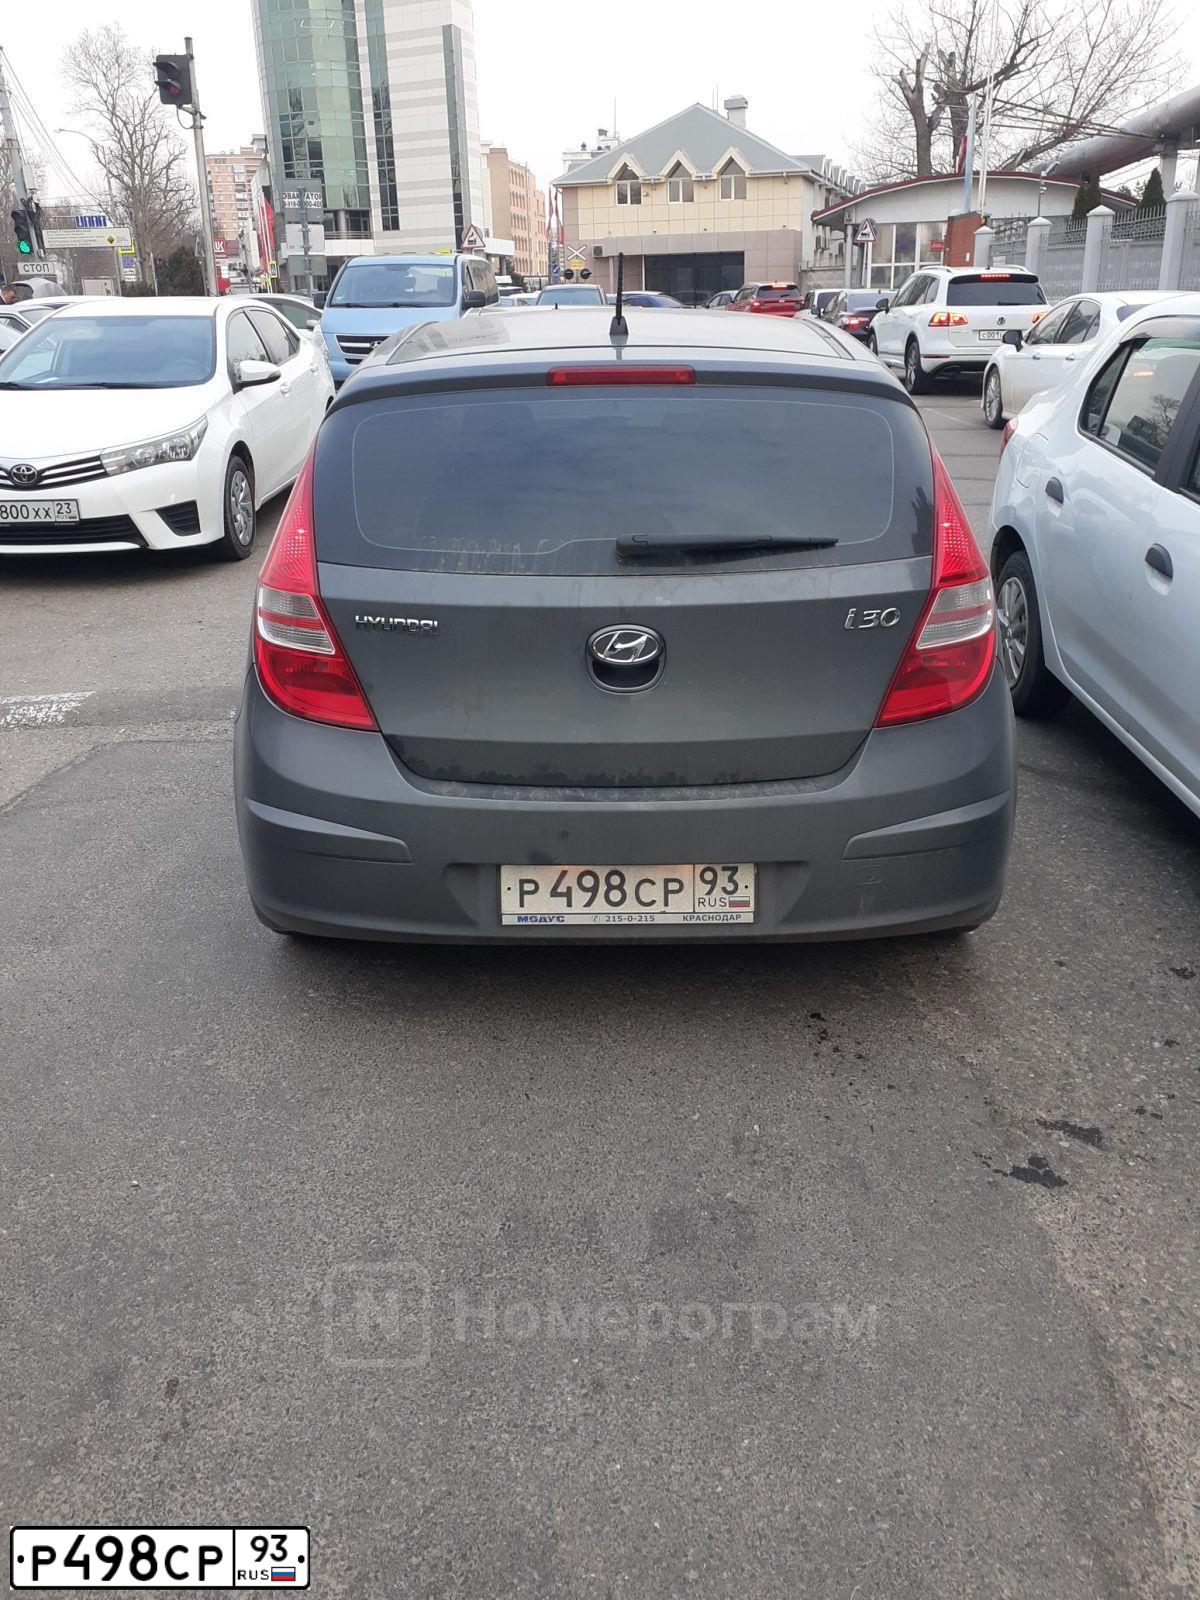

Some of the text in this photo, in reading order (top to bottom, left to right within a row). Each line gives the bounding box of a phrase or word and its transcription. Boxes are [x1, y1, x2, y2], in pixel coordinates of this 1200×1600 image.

[23, 263, 50, 272] СТОП
[56, 502, 72, 514] 23
[354, 614, 439, 633] HYUNDAI
[518, 866, 739, 908] Р498СР 93
[697, 897, 728, 908] RUS
[516, 915, 566, 923] МОДУС
[682, 914, 742, 922] КРАСНОДАР
